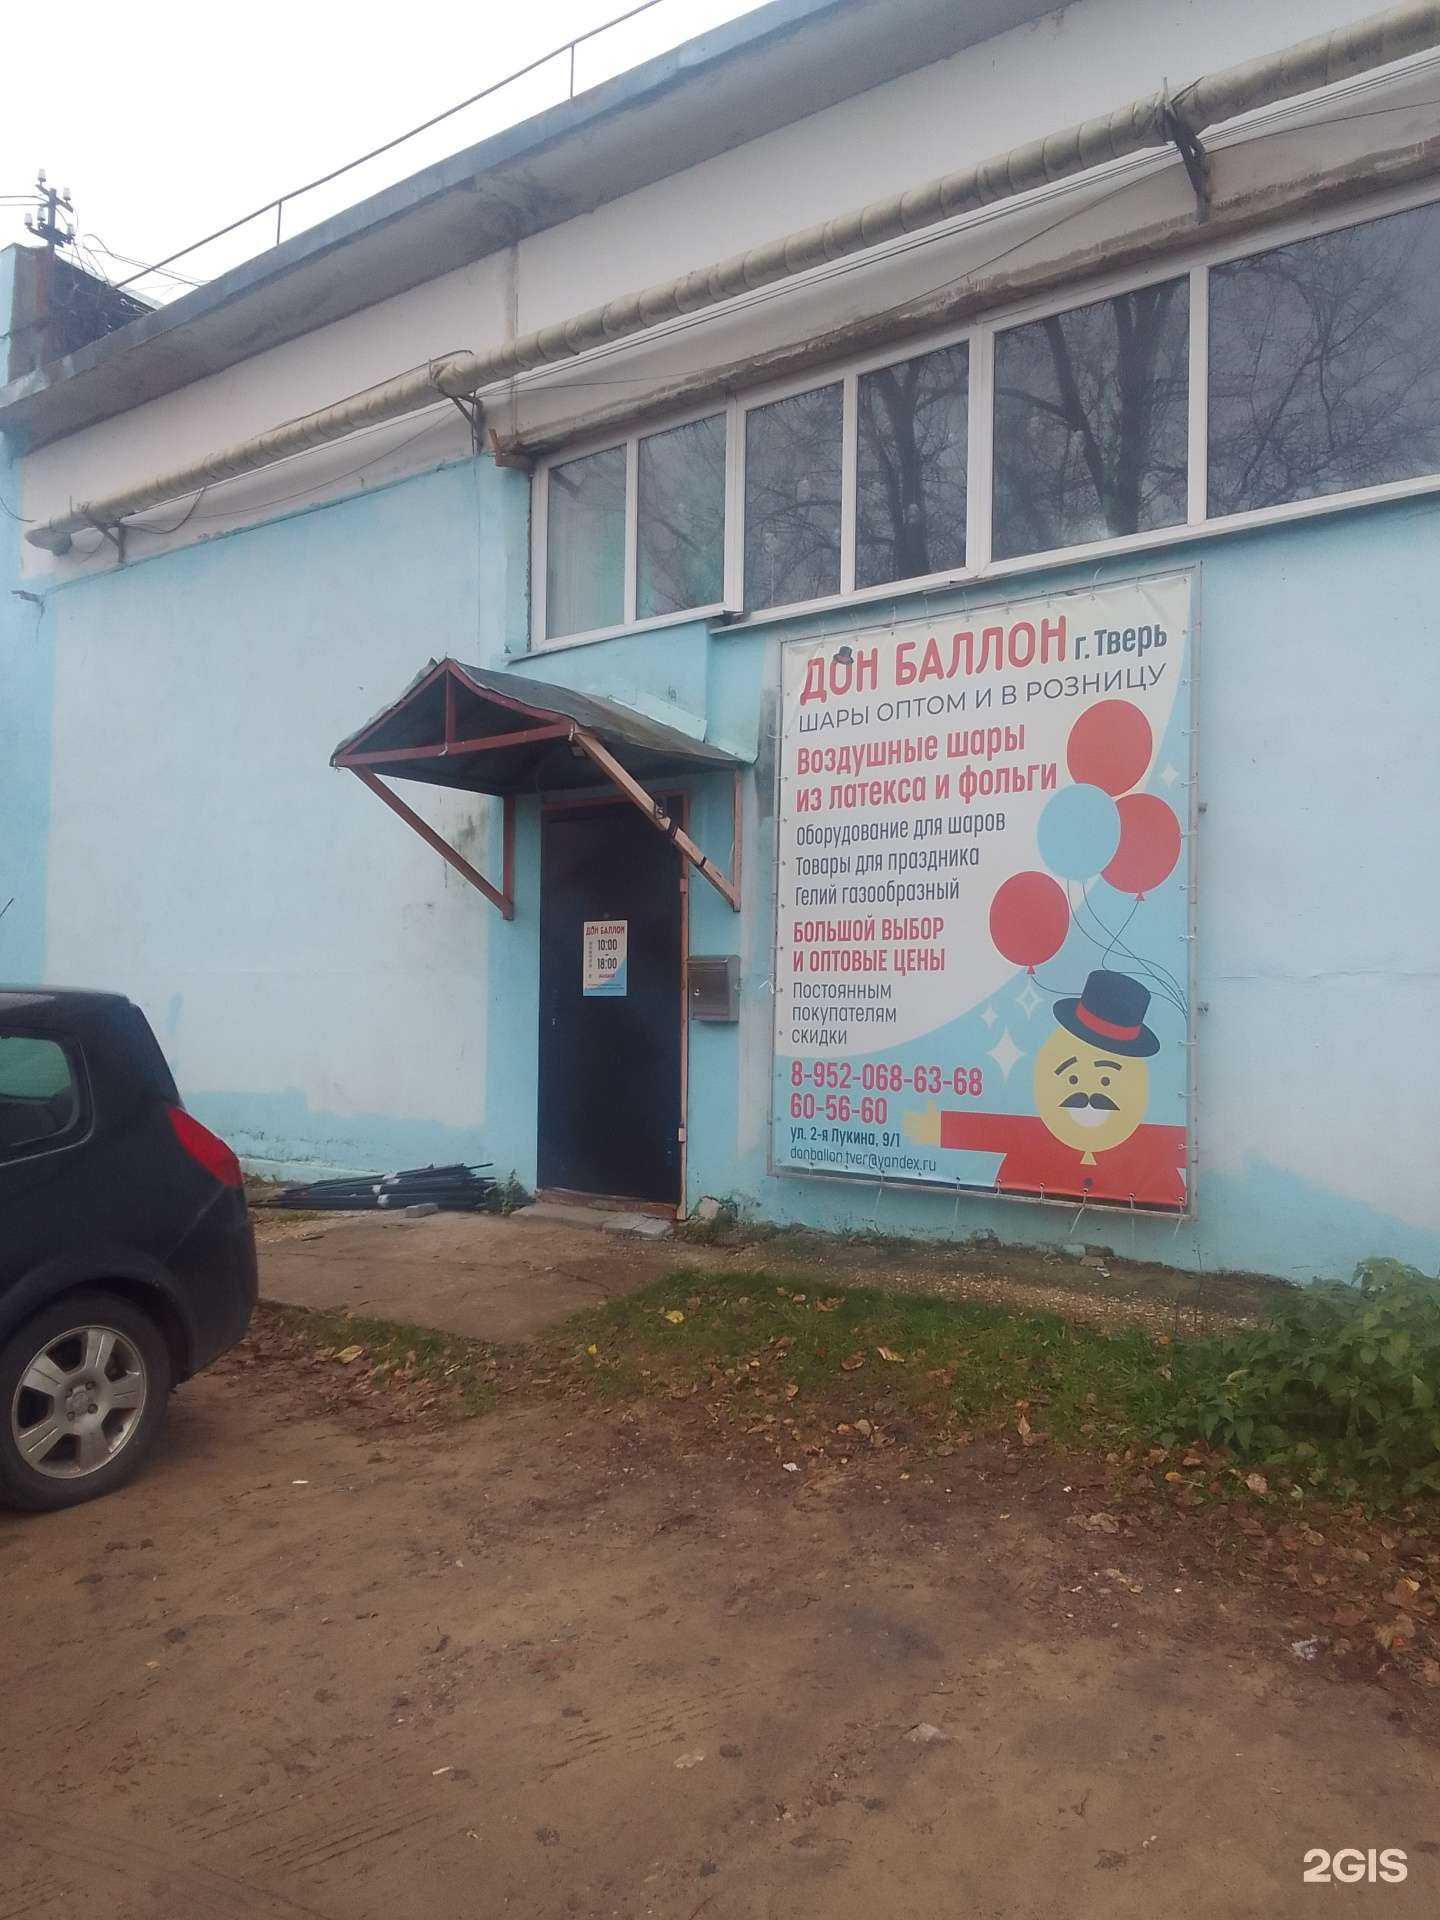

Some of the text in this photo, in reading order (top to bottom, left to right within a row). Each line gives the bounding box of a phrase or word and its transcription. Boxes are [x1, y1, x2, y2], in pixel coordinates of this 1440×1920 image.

[800, 615, 1167, 706] ДОН БАЛЛОН г. Тверь
[799, 662, 1168, 733] ШАРЫ ОПТОМ И В РОЗНИЦУ
[797, 723, 1026, 777] Воздушные шары
[796, 762, 1057, 813] из латекса и фольги
[796, 812, 1006, 848] Оборудование для шаров
[796, 847, 980, 879] Товары для праздника
[795, 877, 960, 907] Гелий газообразный
[793, 913, 945, 943] БОЛЬШОЙ ВЫБОР
[597, 939, 618, 951] 10:00
[596, 958, 618, 970] 18:00
[793, 948, 946, 976] И ОПТОВЫЕ ЦЕНЫ
[793, 982, 892, 999] Постоянным
[792, 1006, 897, 1026] покупателям
[791, 1029, 847, 1046] скидки
[791, 1060, 983, 1097] 8-952-068-63-68
[790, 1092, 888, 1124] 60-56-60
[790, 1126, 901, 1147] ул. 2-я Лукина, 9/1
